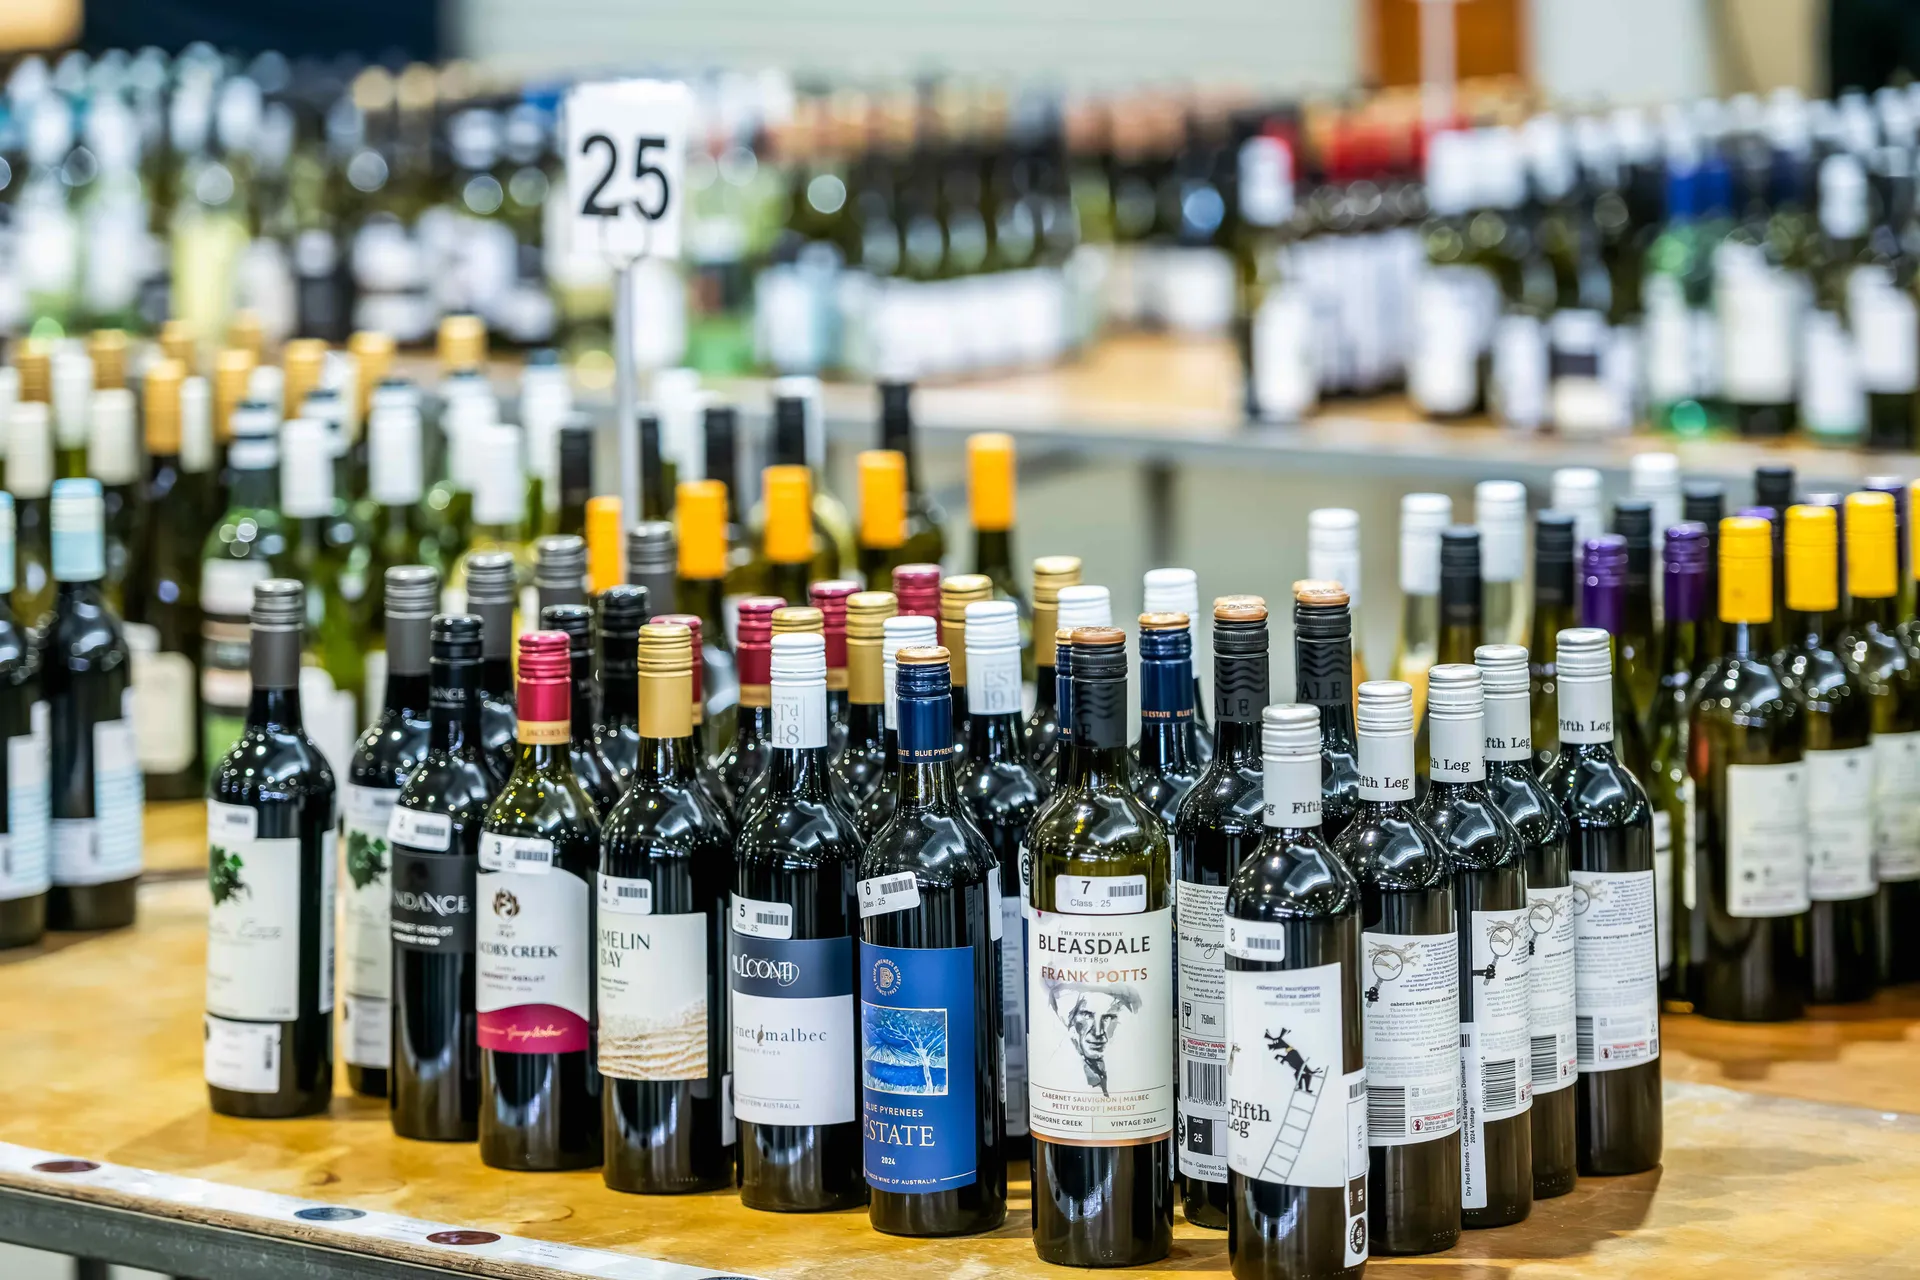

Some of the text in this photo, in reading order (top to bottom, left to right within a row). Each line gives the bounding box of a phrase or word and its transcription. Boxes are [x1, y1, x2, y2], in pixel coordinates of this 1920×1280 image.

[581, 134, 669, 221] 25
[1591, 720, 1611, 733] Leg
[1511, 737, 1531, 750] Leg
[914, 749, 933, 757] BLUE
[1443, 758, 1471, 773] Leg
[1384, 776, 1410, 790] Leg
[494, 841, 502, 856] 3
[602, 879, 608, 892] 4
[865, 881, 871, 896] 6
[1081, 880, 1091, 895] 7
[878, 897, 886, 906] 25
[1070, 898, 1111, 908] Class 25
[739, 904, 746, 918] 5
[750, 924, 759, 933] 25
[1230, 927, 1236, 942] 8
[1039, 933, 1151, 955] BLEASDALE
[511, 944, 559, 959] CREEK
[600, 948, 623, 968] BAY
[1041, 966, 1148, 983] FRANK POTTS
[765, 1028, 827, 1043] malbec
[1041, 1091, 1071, 1102] CABERNET
[1123, 1093, 1150, 1102] MALBEC
[763, 1101, 800, 1110] AUSTRALIA
[865, 1101, 924, 1118] BLUE PYRENEES
[1052, 1102, 1136, 1112] PETIT VERDOT MERLOT
[1230, 1097, 1272, 1123] Fifth
[1061, 1119, 1083, 1127] CREEK
[1110, 1118, 1141, 1127] VINTAGE
[1227, 1110, 1251, 1139] Leg
[863, 1114, 936, 1147] ESTATE
[1193, 1132, 1203, 1144] 25
[880, 1156, 896, 1166] 2024
[901, 1178, 937, 1186] AUSTRALIA
